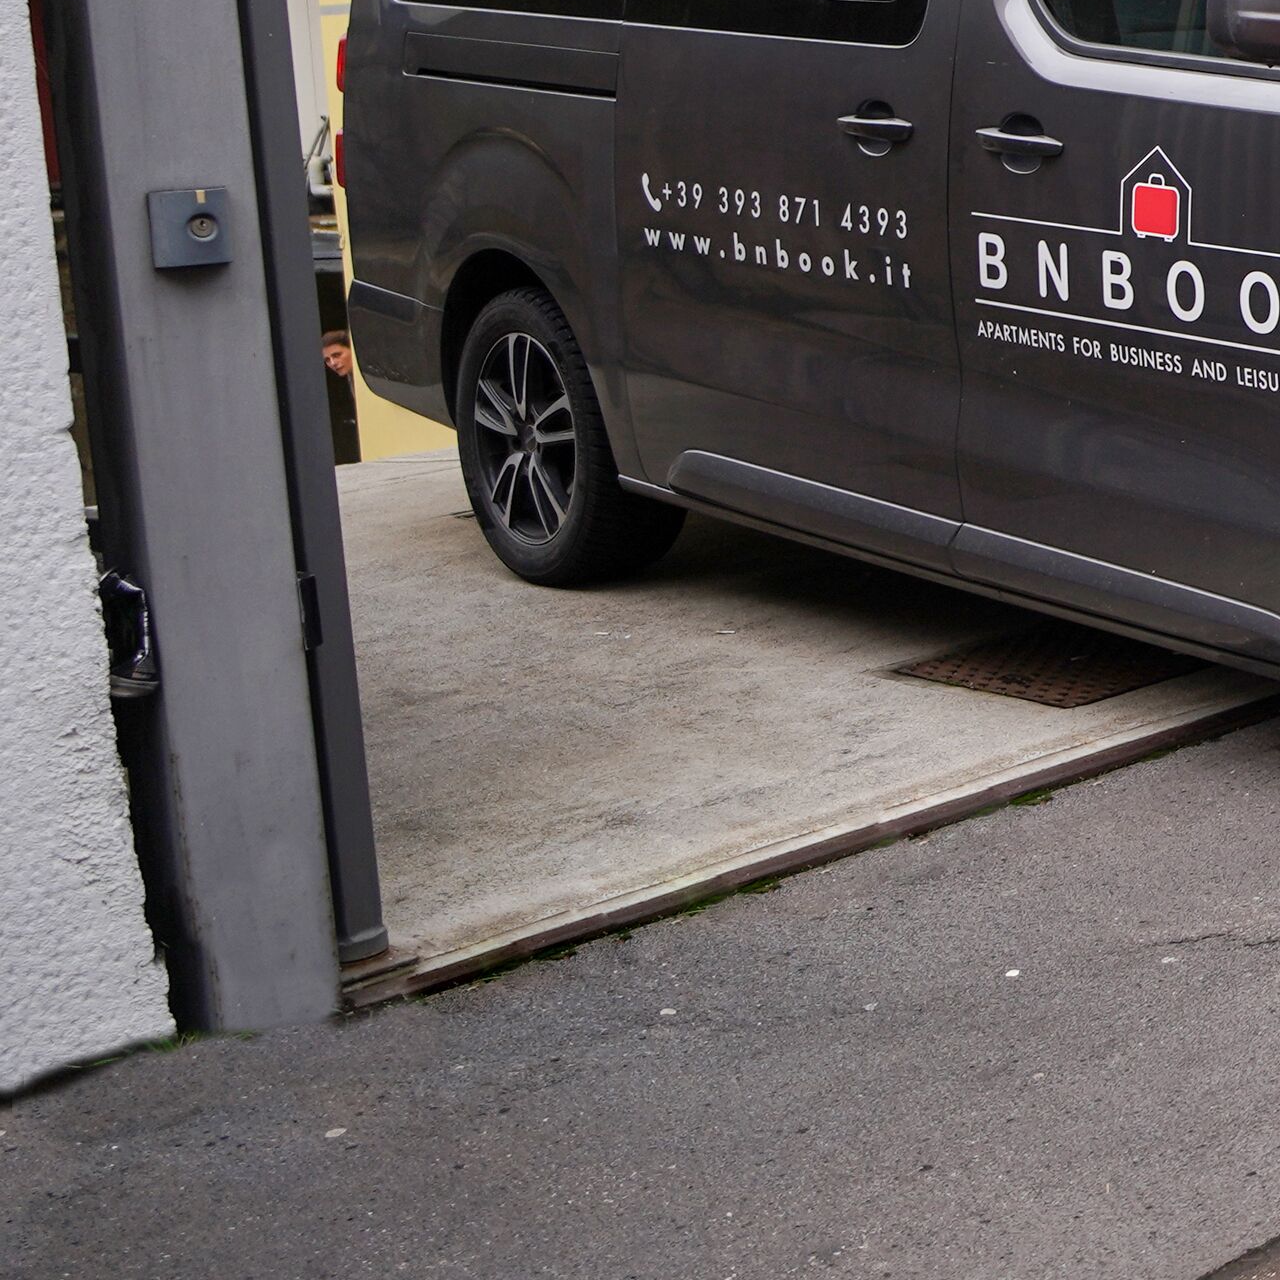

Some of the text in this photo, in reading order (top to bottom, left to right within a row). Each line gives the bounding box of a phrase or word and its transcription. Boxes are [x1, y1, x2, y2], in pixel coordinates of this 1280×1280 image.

[662, 181, 908, 239] +39 393 871 4393
[644, 227, 912, 289] www.bnbook.it
[977, 320, 1066, 352] APARTMENTS
[1072, 337, 1103, 360] FOR
[1110, 343, 1183, 374] BUSINESS
[1191, 358, 1228, 383] AND
